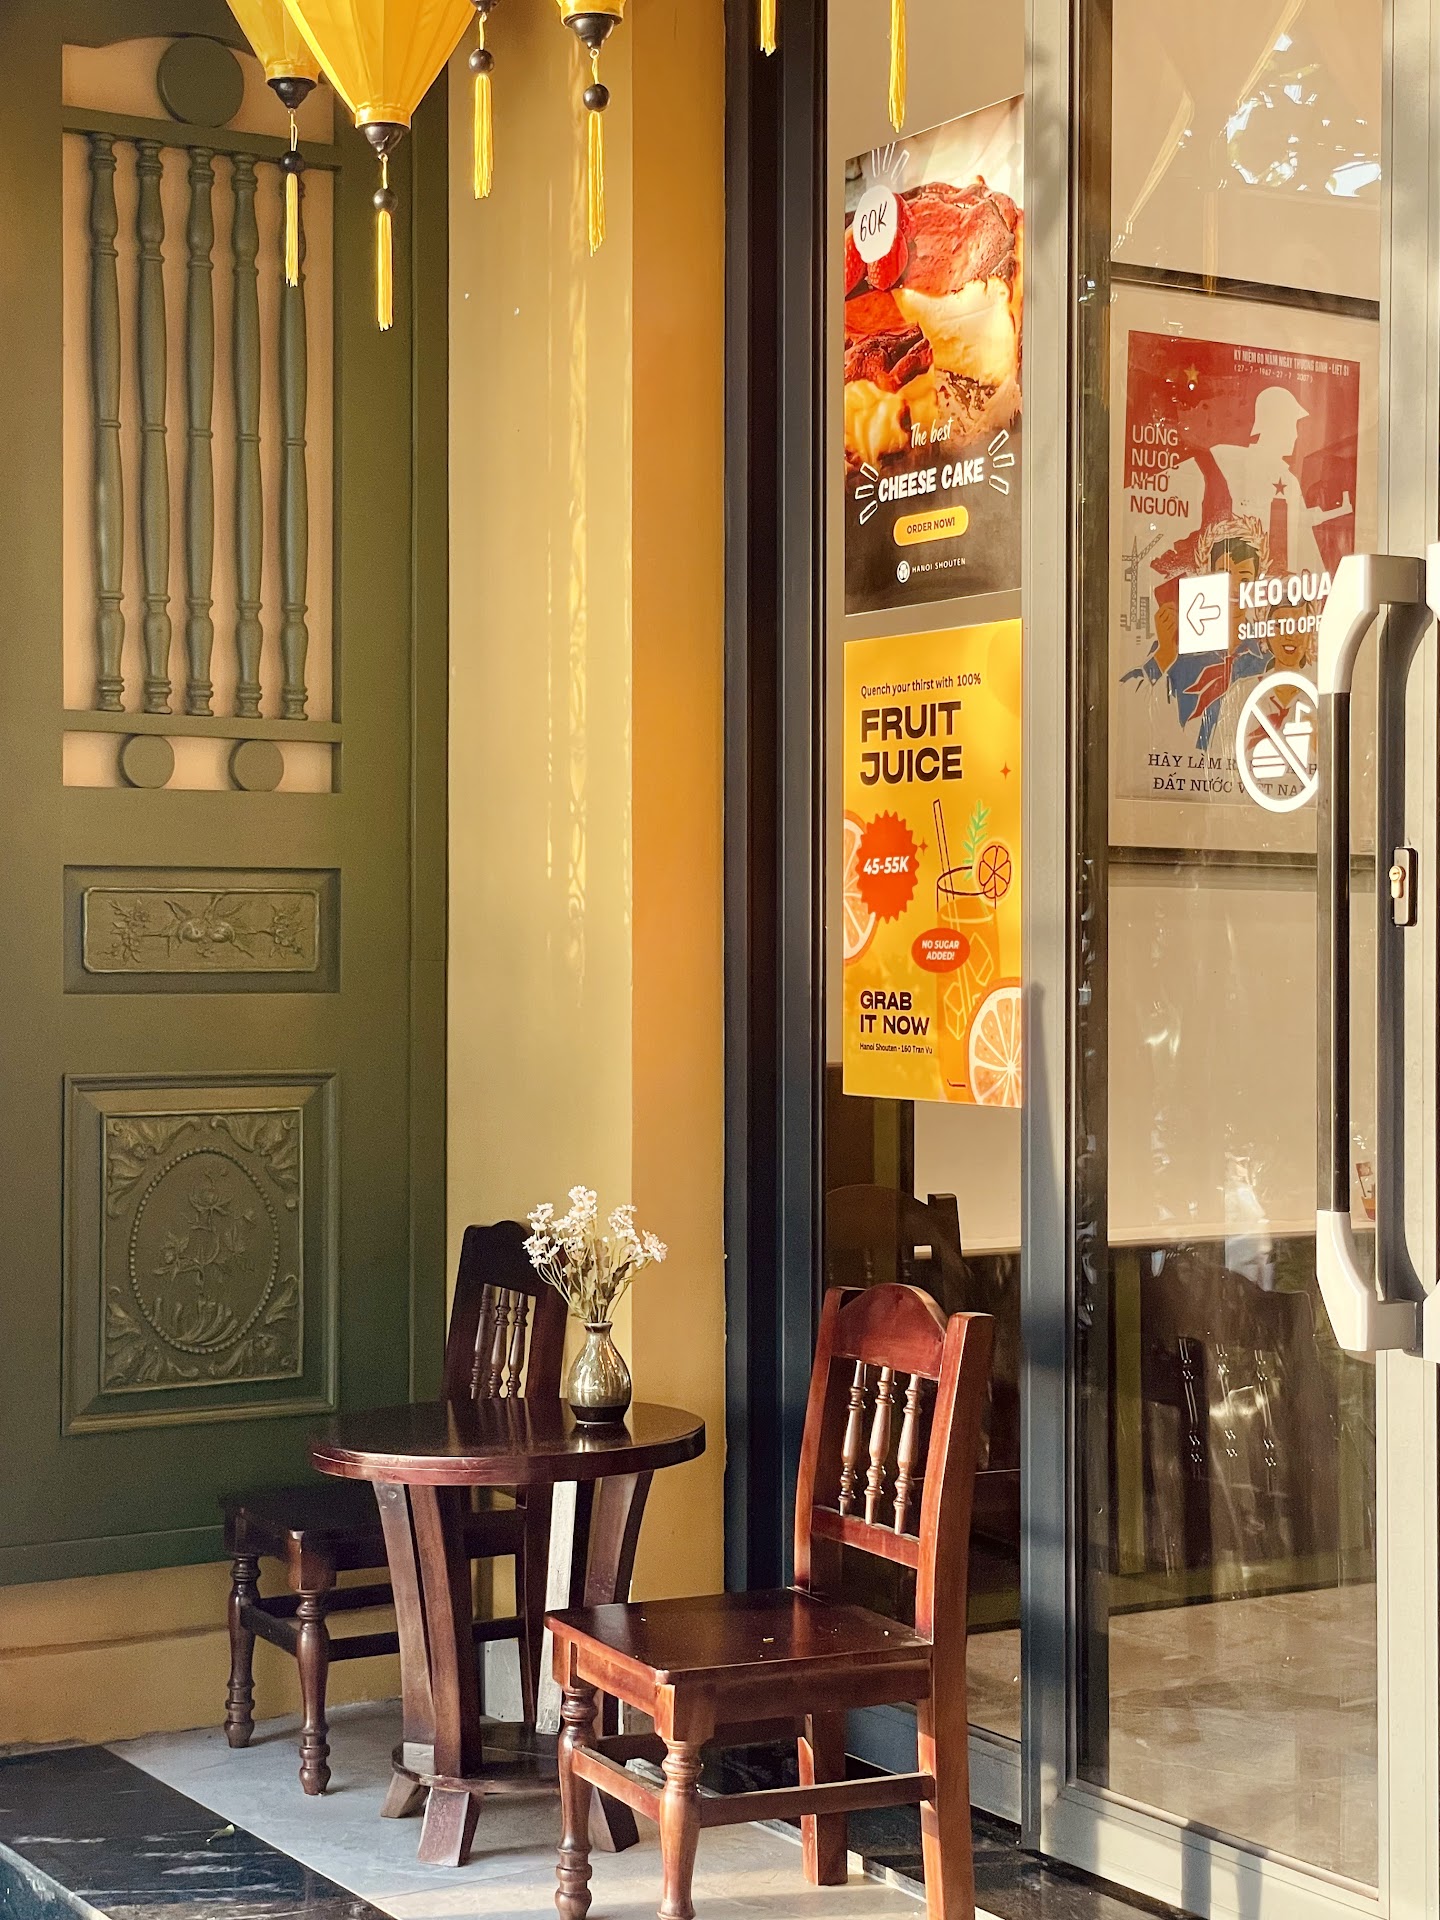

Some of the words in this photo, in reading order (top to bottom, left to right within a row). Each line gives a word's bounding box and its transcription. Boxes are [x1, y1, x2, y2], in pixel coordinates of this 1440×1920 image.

[860, 201, 887, 242] 60K
[910, 422, 926, 448] The
[930, 417, 954, 444] best
[878, 467, 937, 503] CHEESE
[941, 457, 985, 489] CAKE
[906, 521, 932, 535] ORDER
[933, 517, 956, 530] NOW!
[912, 563, 933, 573] HANOI
[934, 557, 966, 571] SHOUTEN
[1239, 573, 1282, 609] KÉO
[1287, 571, 1332, 606] QUA
[1238, 619, 1276, 640] SLIDE
[1278, 618, 1295, 636] TO
[1297, 614, 1323, 634] OP
[861, 683, 890, 699] Quench
[892, 683, 911, 697] your
[912, 678, 934, 692] thirst
[936, 676, 953, 689] with
[957, 672, 981, 687] 100%
[861, 701, 962, 743] FRUIT
[860, 745, 962, 786] JUICE
[1147, 751, 1182, 768] HÃY
[1153, 772, 1185, 791] ĐẤT
[1190, 776, 1232, 793] NƯỚC
[1238, 779, 1273, 796] VT
[1278, 784, 1306, 797] NA
[863, 855, 909, 875] 45-55K
[921, 940, 933, 949] NO
[934, 940, 960, 950] SUGAR
[926, 951, 955, 960] ADDED!
[860, 990, 912, 1010] GRAB
[860, 1014, 877, 1033] IT
[883, 1015, 930, 1036] NOW
[860, 1042, 875, 1051] Hanoi
[875, 1043, 897, 1052] Shouten
[913, 1045, 924, 1054] Tran
[925, 1046, 933, 1054] Vu
